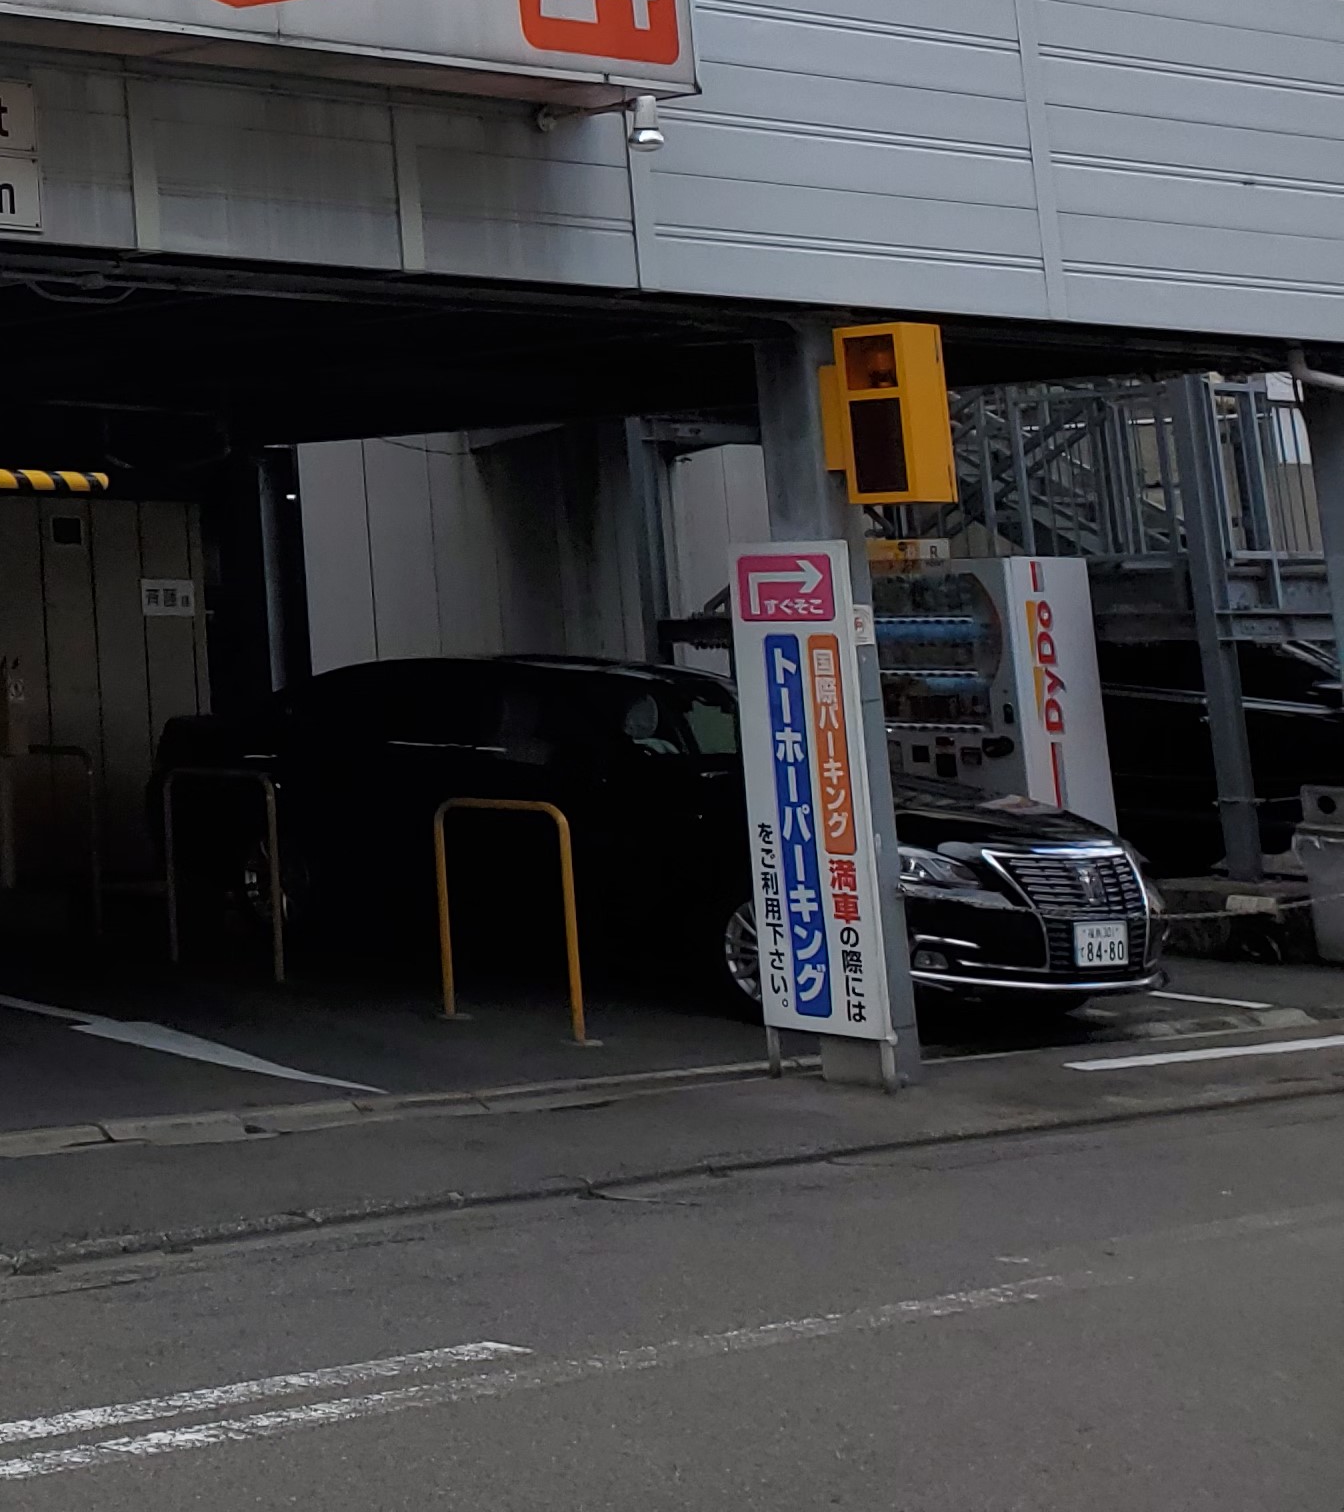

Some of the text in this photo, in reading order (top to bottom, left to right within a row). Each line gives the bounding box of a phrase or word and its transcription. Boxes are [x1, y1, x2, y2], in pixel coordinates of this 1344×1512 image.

[764, 599, 824, 615] すぐそこ
[773, 647, 826, 1002] トーホーパーキング
[1087, 940, 1124, 963] 84-80
